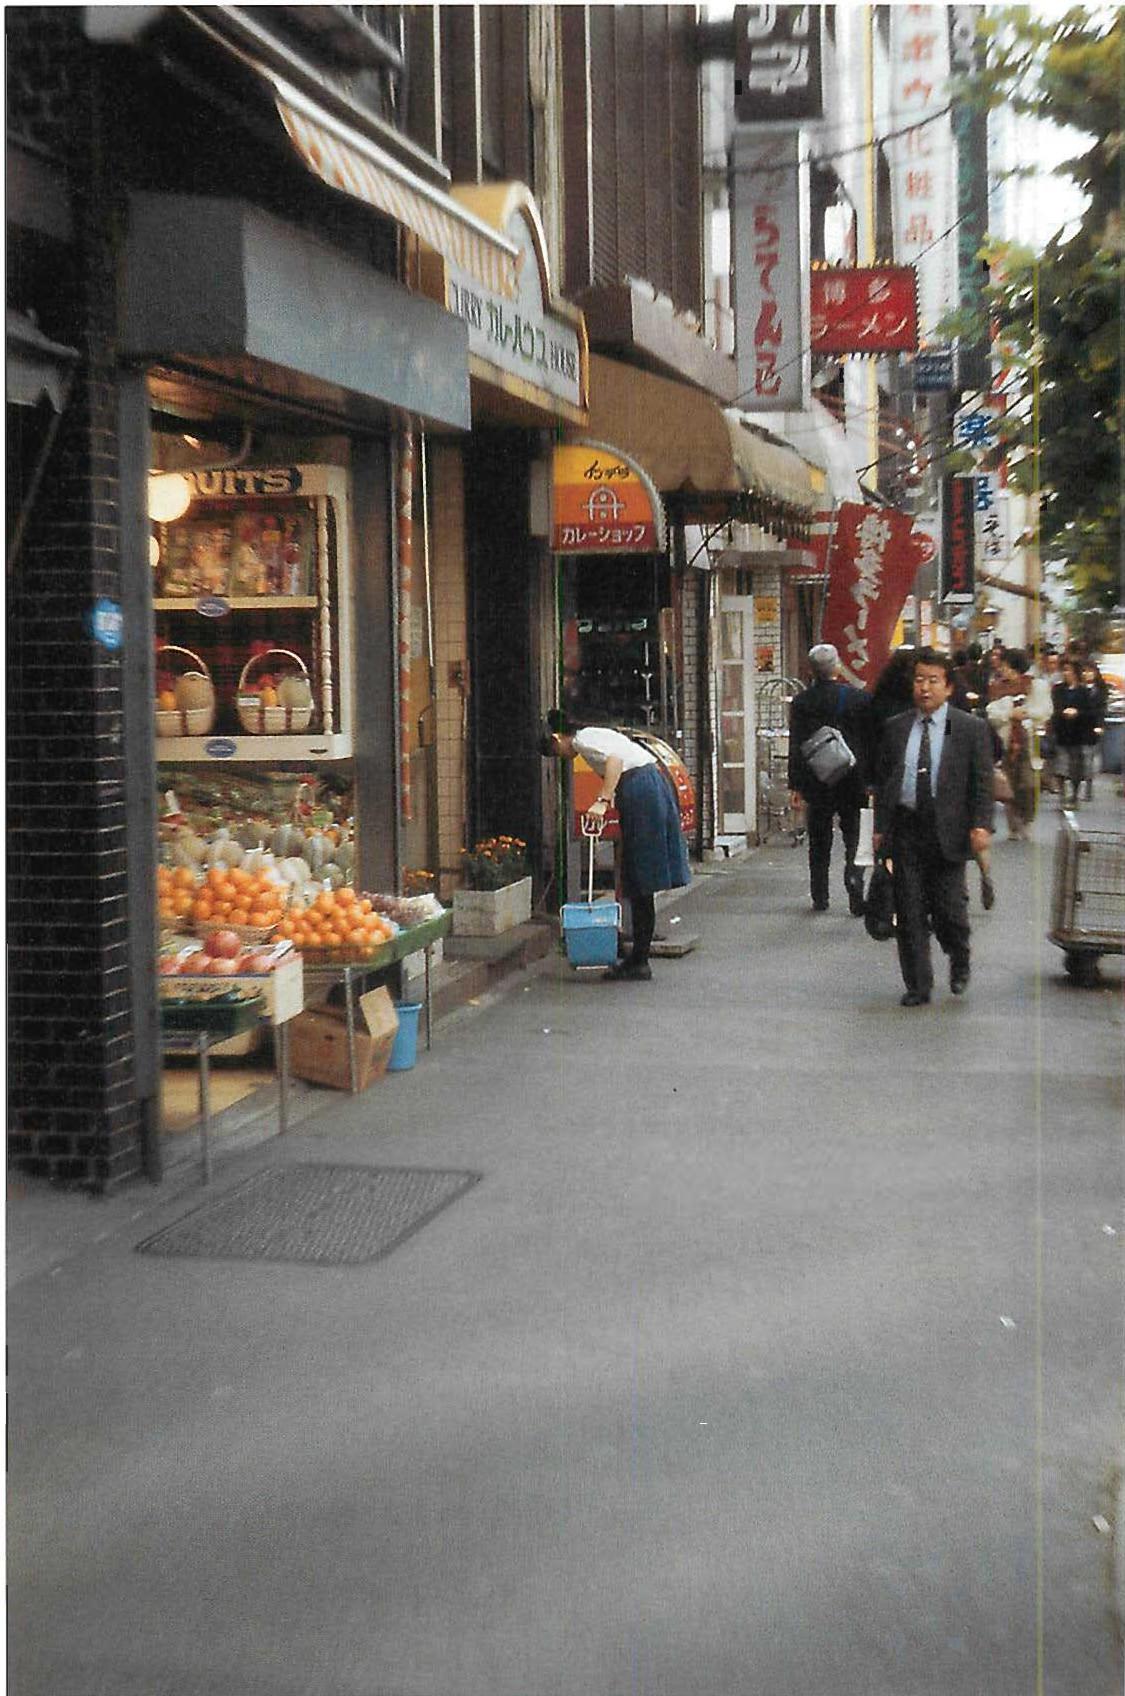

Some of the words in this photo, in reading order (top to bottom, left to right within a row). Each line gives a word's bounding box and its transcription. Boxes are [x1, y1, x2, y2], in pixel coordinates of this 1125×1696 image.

[902, 4, 936, 244] ボウ化粧品
[811, 312, 909, 340] ラーメン
[188, 469, 292, 494] UITS
